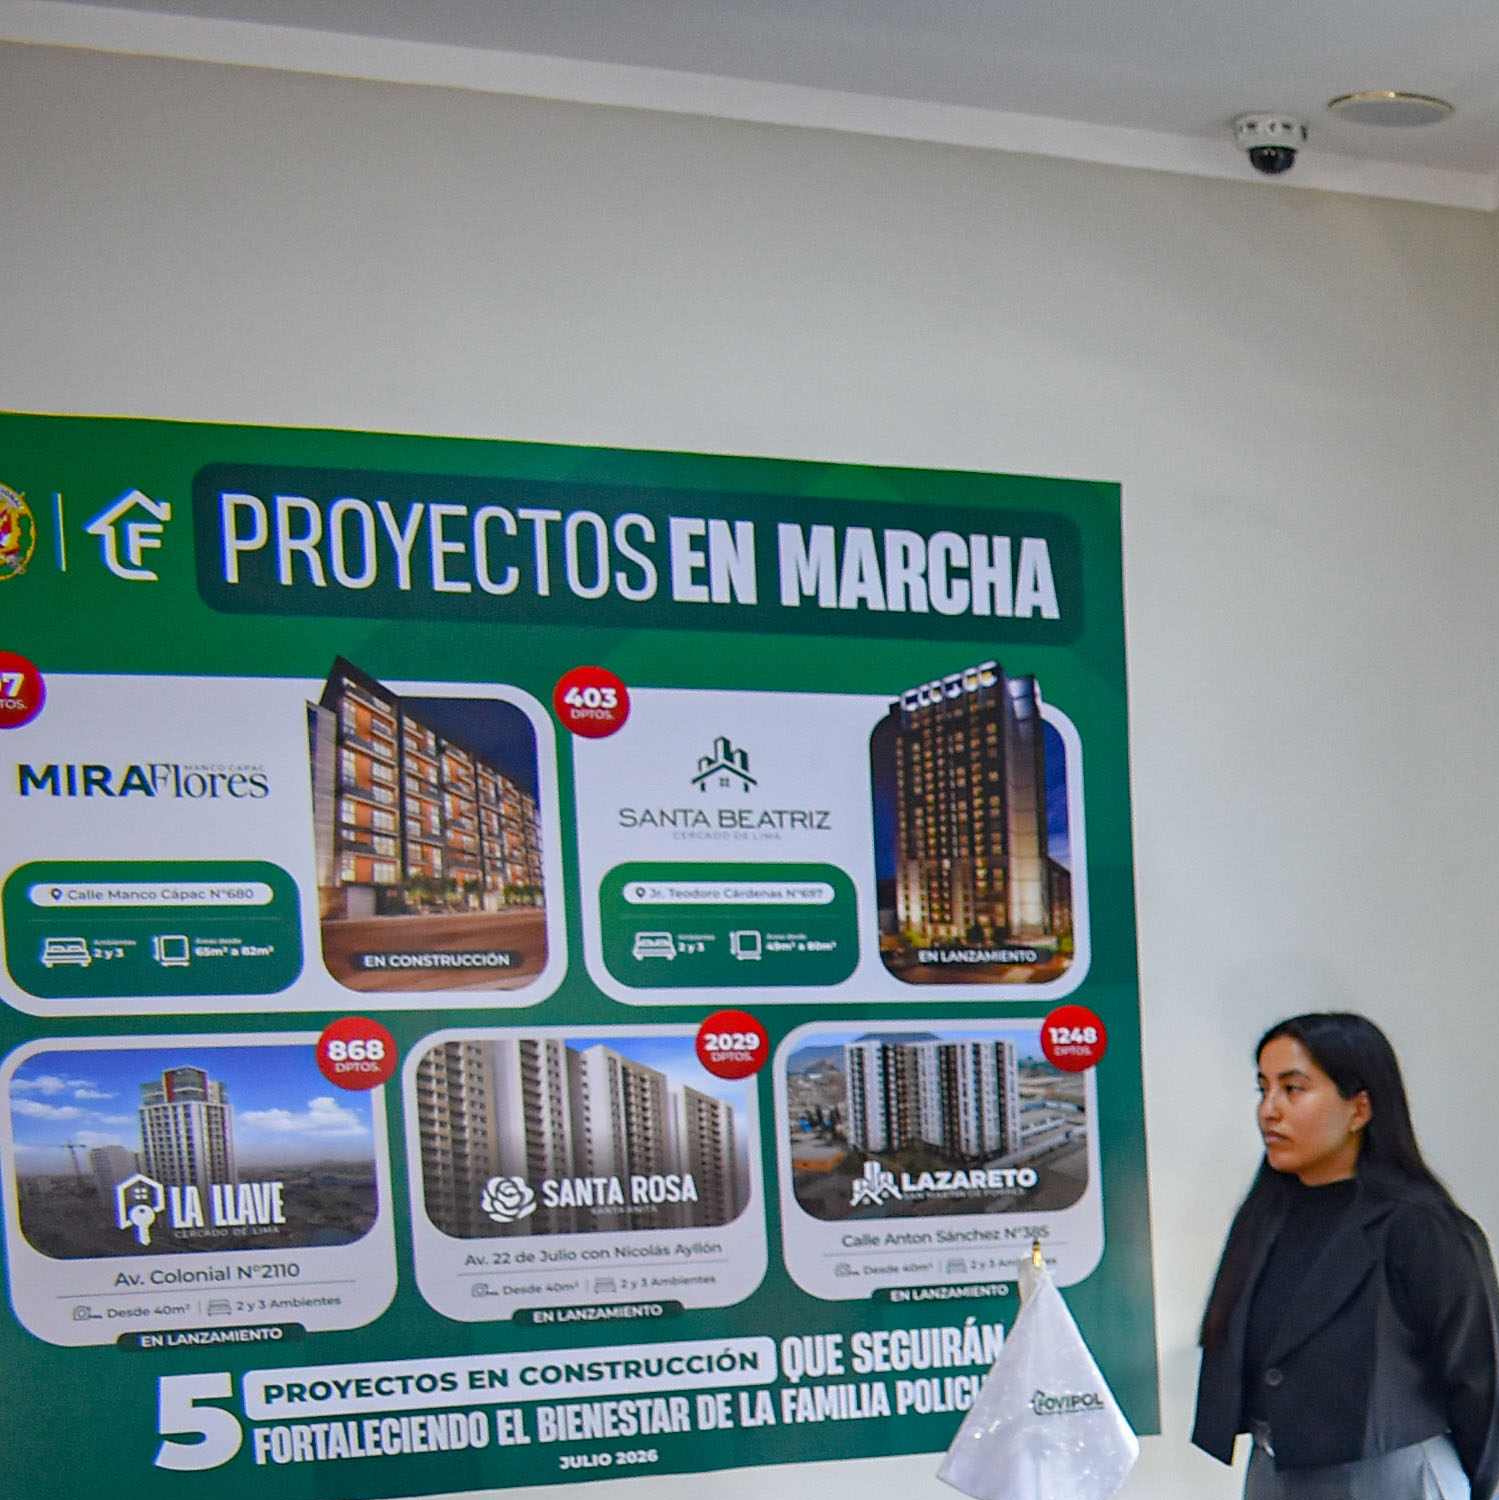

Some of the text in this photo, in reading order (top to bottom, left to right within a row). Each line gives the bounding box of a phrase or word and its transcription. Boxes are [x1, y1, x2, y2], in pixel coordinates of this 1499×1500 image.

[221, 493, 1061, 619] PROYECTOS EN MARCHA
[0, 672, 25, 697] 7
[564, 687, 618, 709] 403
[619, 808, 831, 830] SANTA BEATRIZ
[68, 889, 103, 900] Calle
[108, 889, 157, 900] Manco
[364, 952, 510, 968] EN CONSTRUCCIÓN
[918, 950, 1038, 964] EN LANZAMIENTO
[704, 1031, 760, 1052] 2029
[1048, 1027, 1098, 1046] 1248
[328, 1039, 385, 1061] 868
[901, 1167, 1038, 1192] LAZARETO
[541, 1173, 699, 1208] SANTA ROSA
[168, 1181, 286, 1229] LA LLAVE
[174, 1226, 280, 1240] CERCADO DE LIMA
[842, 1234, 880, 1248] Calle
[936, 1228, 1000, 1242] Sánchez
[464, 1254, 489, 1266] Av.
[493, 1253, 511, 1265] 22
[515, 1251, 535, 1263] de
[540, 1249, 577, 1263] Julio
[581, 1250, 611, 1261] con
[614, 1244, 670, 1259] Nicolás
[114, 1262, 300, 1287] Av. Colonial N°2110
[629, 1281, 638, 1291] y
[651, 1274, 716, 1287] Ambientes
[503, 1284, 542, 1295] Desde
[890, 1284, 1010, 1302] EN LANZAMIENTO
[107, 1303, 192, 1319] Desde 40m²
[236, 1295, 342, 1315] 2 y 3 Ambientes
[533, 1304, 663, 1324] EN LANZAMIENTO
[141, 1327, 283, 1348] EN LANZAMIENTO
[153, 1316, 1004, 1471] 5 PROYECTOS EN CONSTRUCCIÓN QUE SEGUIRÁN
[253, 1373, 986, 1466] FORTALECIENDO EL BIENESTAR DE LA FAMILIA POLICI
[559, 1448, 658, 1469] JULIO 2026
